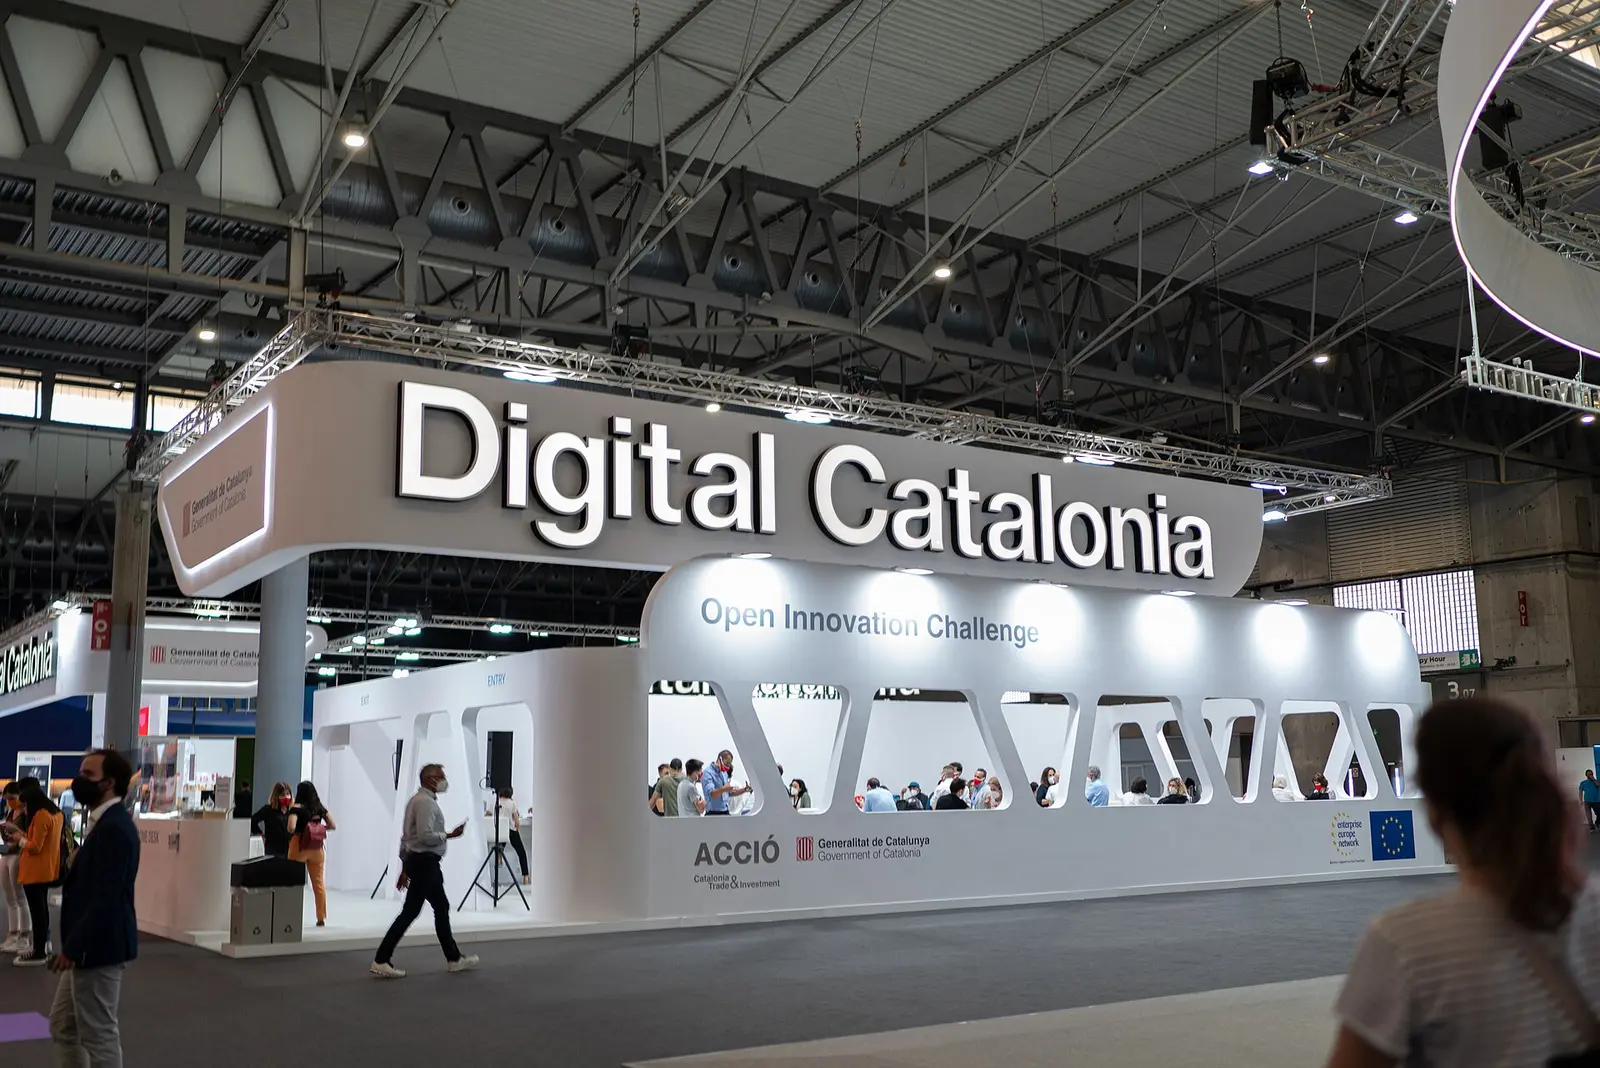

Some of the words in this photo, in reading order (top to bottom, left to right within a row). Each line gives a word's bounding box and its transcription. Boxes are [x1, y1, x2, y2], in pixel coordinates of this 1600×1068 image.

[398, 380, 776, 550] Digital
[808, 443, 1216, 580] Catalonia
[219, 481, 225, 497] de
[701, 597, 775, 632] Open
[785, 603, 918, 637] Innovation
[927, 613, 1039, 648] Challenge
[170, 648, 217, 658] Generalitat
[220, 649, 231, 658] de
[7, 630, 53, 693] Catalonia
[170, 657, 218, 667] Government
[220, 658, 228, 667] of
[487, 673, 506, 687] ENTRY
[360, 694, 370, 706] EXIT
[1337, 820, 1362, 830] enterprise
[1337, 831, 1355, 839] europe
[818, 837, 869, 849] Generalitat
[872, 836, 884, 847] de
[885, 836, 930, 847] Catalunya
[1338, 838, 1360, 847] network
[693, 834, 780, 866] ACCIÓ
[818, 849, 870, 862] Government
[872, 849, 882, 859] of
[883, 848, 921, 859] Catalonia
[693, 875, 730, 884] Catalonia
[708, 882, 730, 891] Trade
[739, 879, 780, 889] Investment
